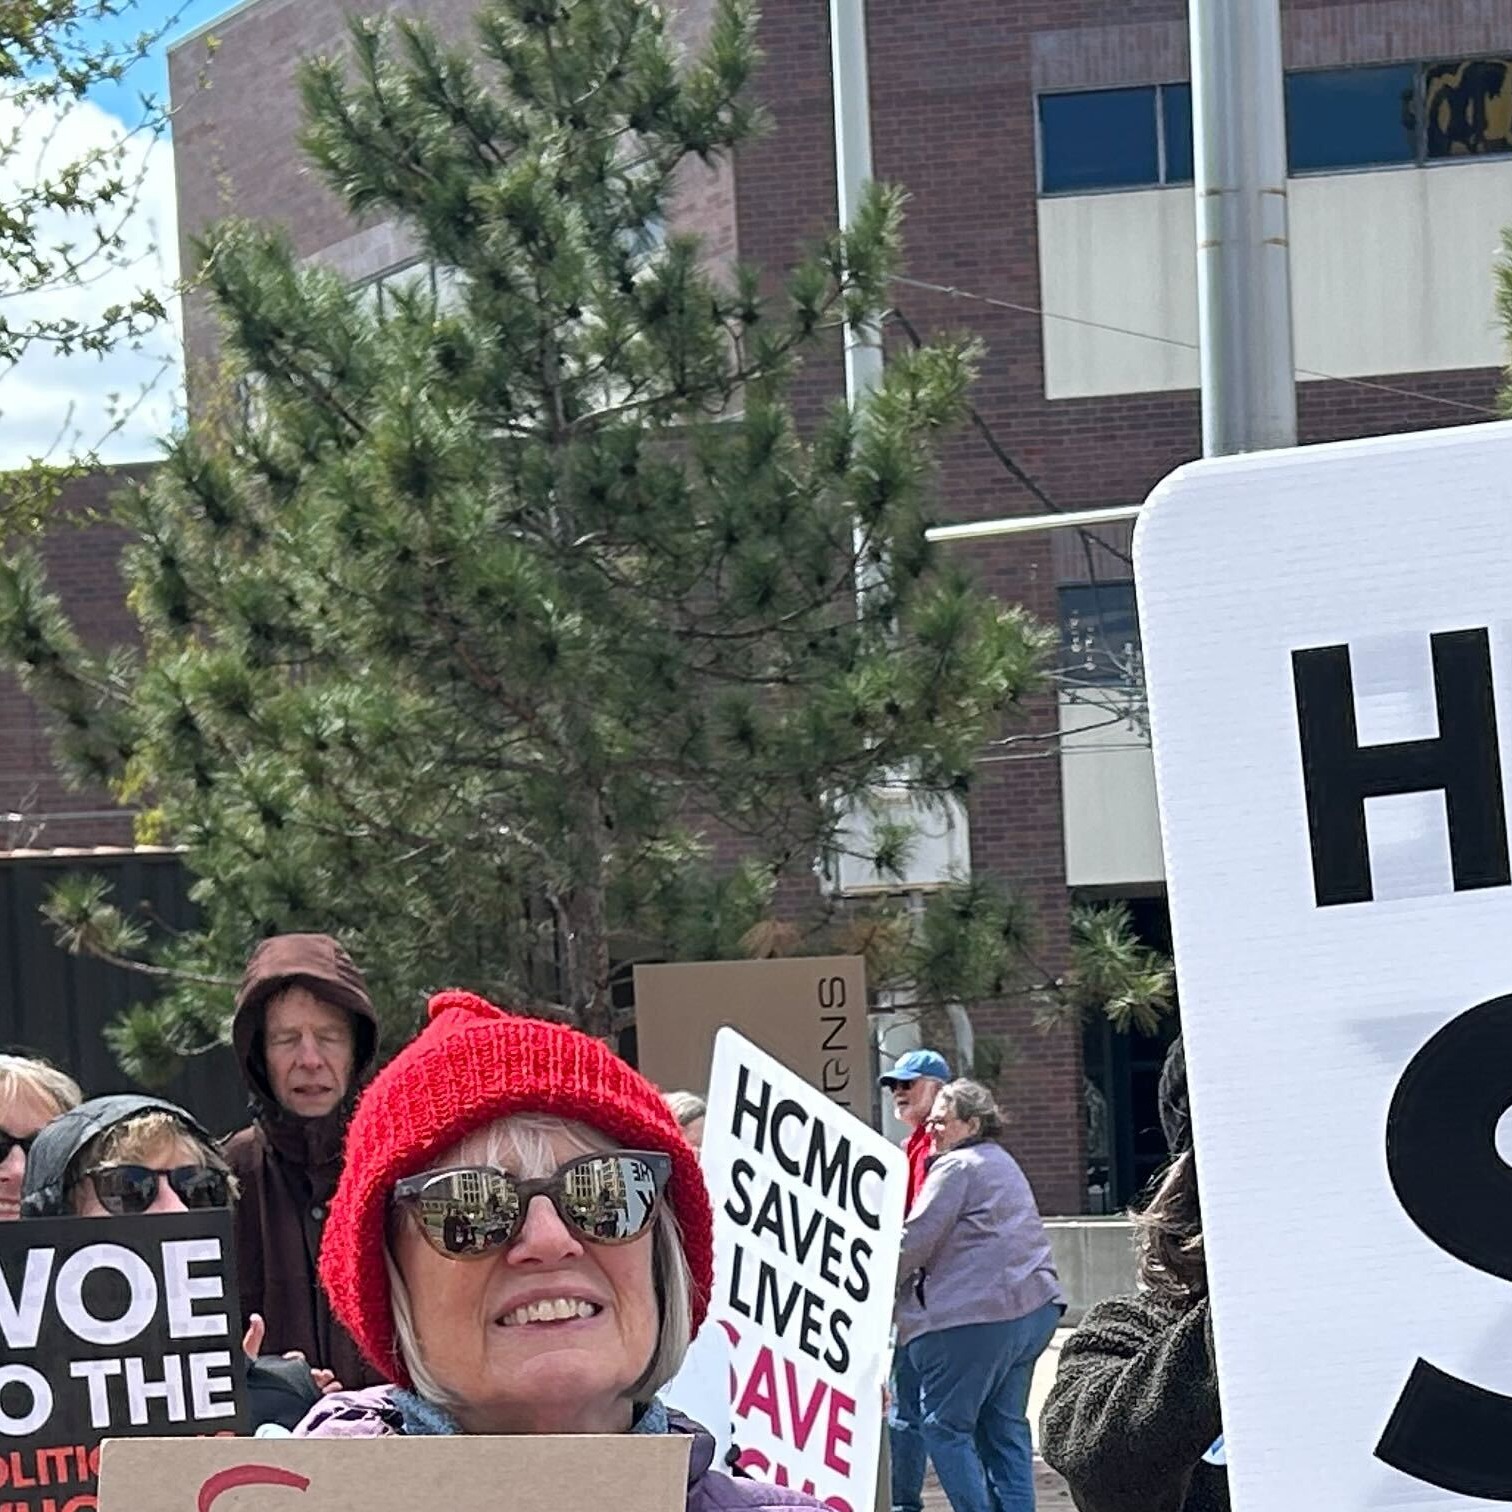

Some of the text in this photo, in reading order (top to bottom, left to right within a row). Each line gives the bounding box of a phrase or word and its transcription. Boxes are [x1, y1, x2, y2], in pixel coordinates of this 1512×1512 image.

[731, 1064, 887, 1231] HCMC
[723, 1158, 874, 1303] SAVES
[729, 1243, 853, 1374] LIVES
[70, 1351, 237, 1428] THE
